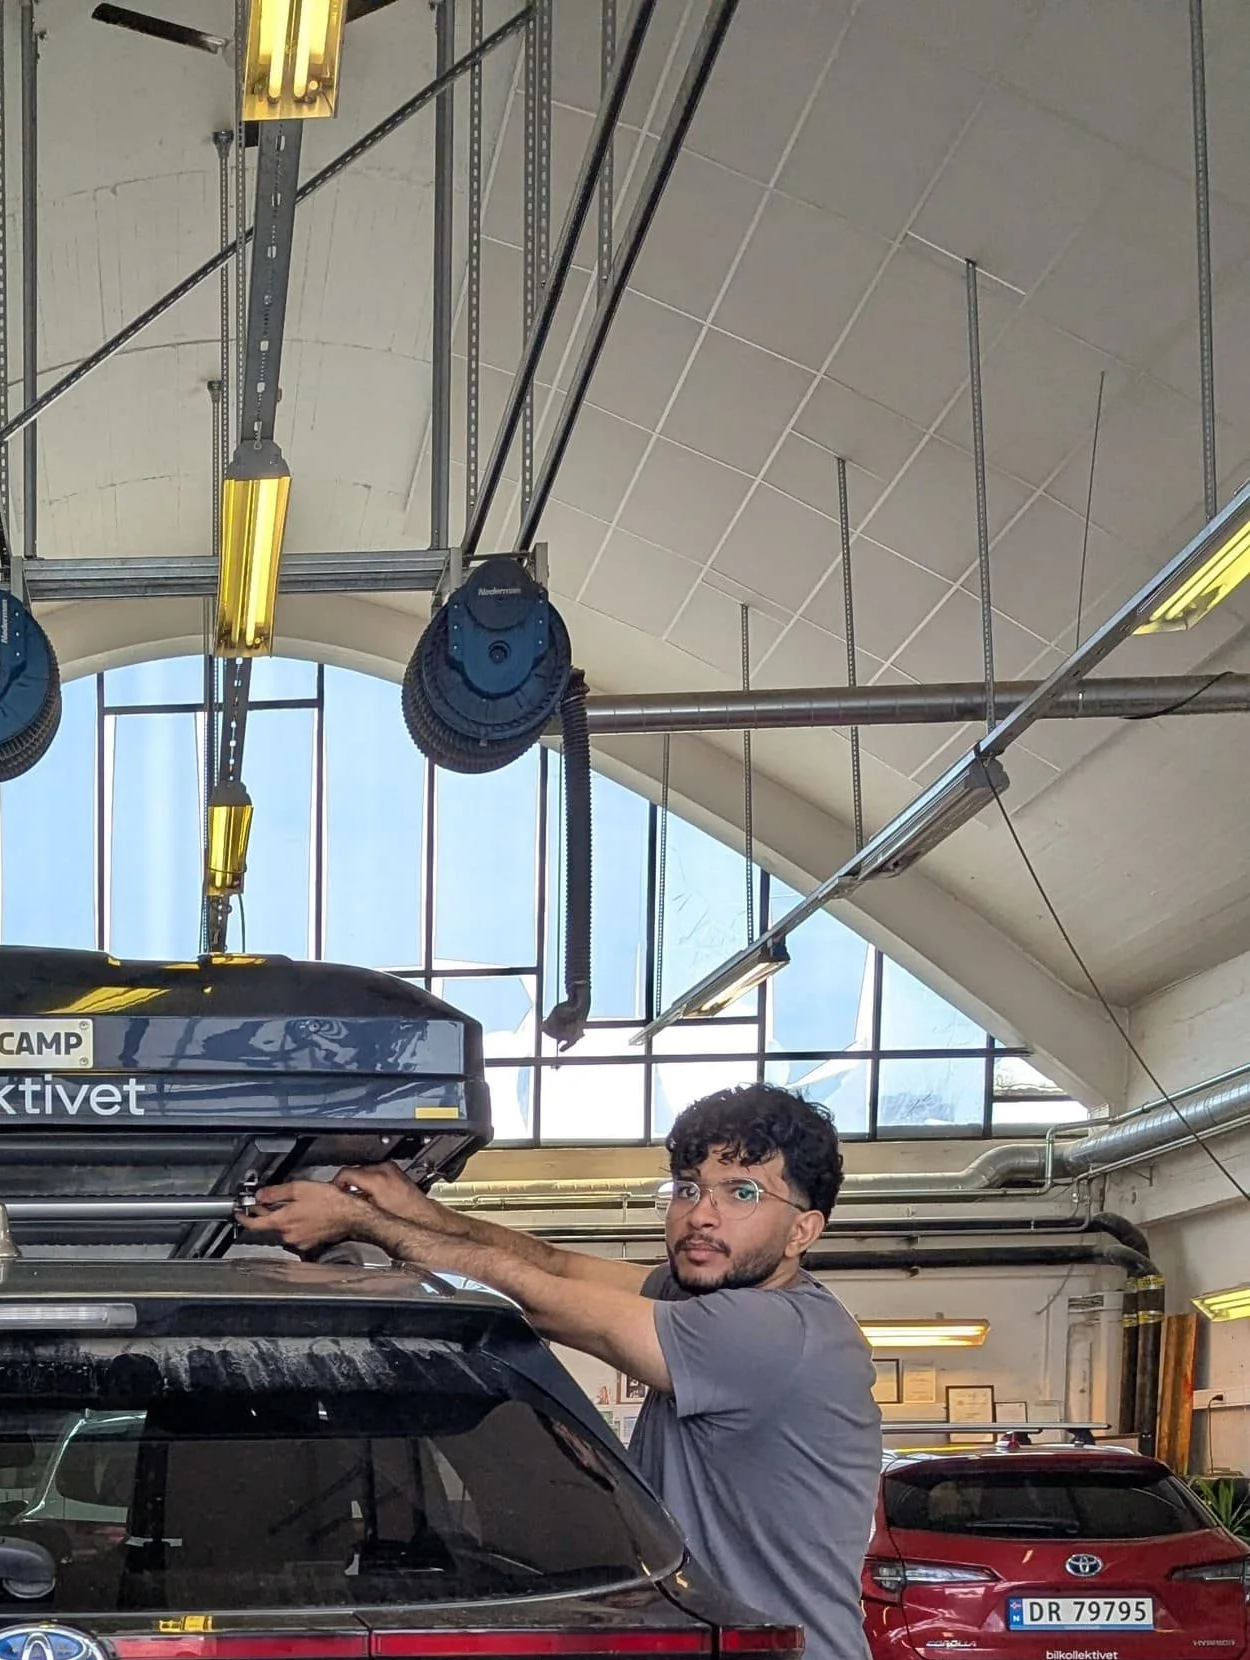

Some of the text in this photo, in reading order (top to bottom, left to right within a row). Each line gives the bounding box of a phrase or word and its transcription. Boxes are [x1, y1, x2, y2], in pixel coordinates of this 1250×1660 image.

[1029, 1601, 1146, 1622] DR 79795
[1046, 1649, 1118, 1660] bilkollektivet
